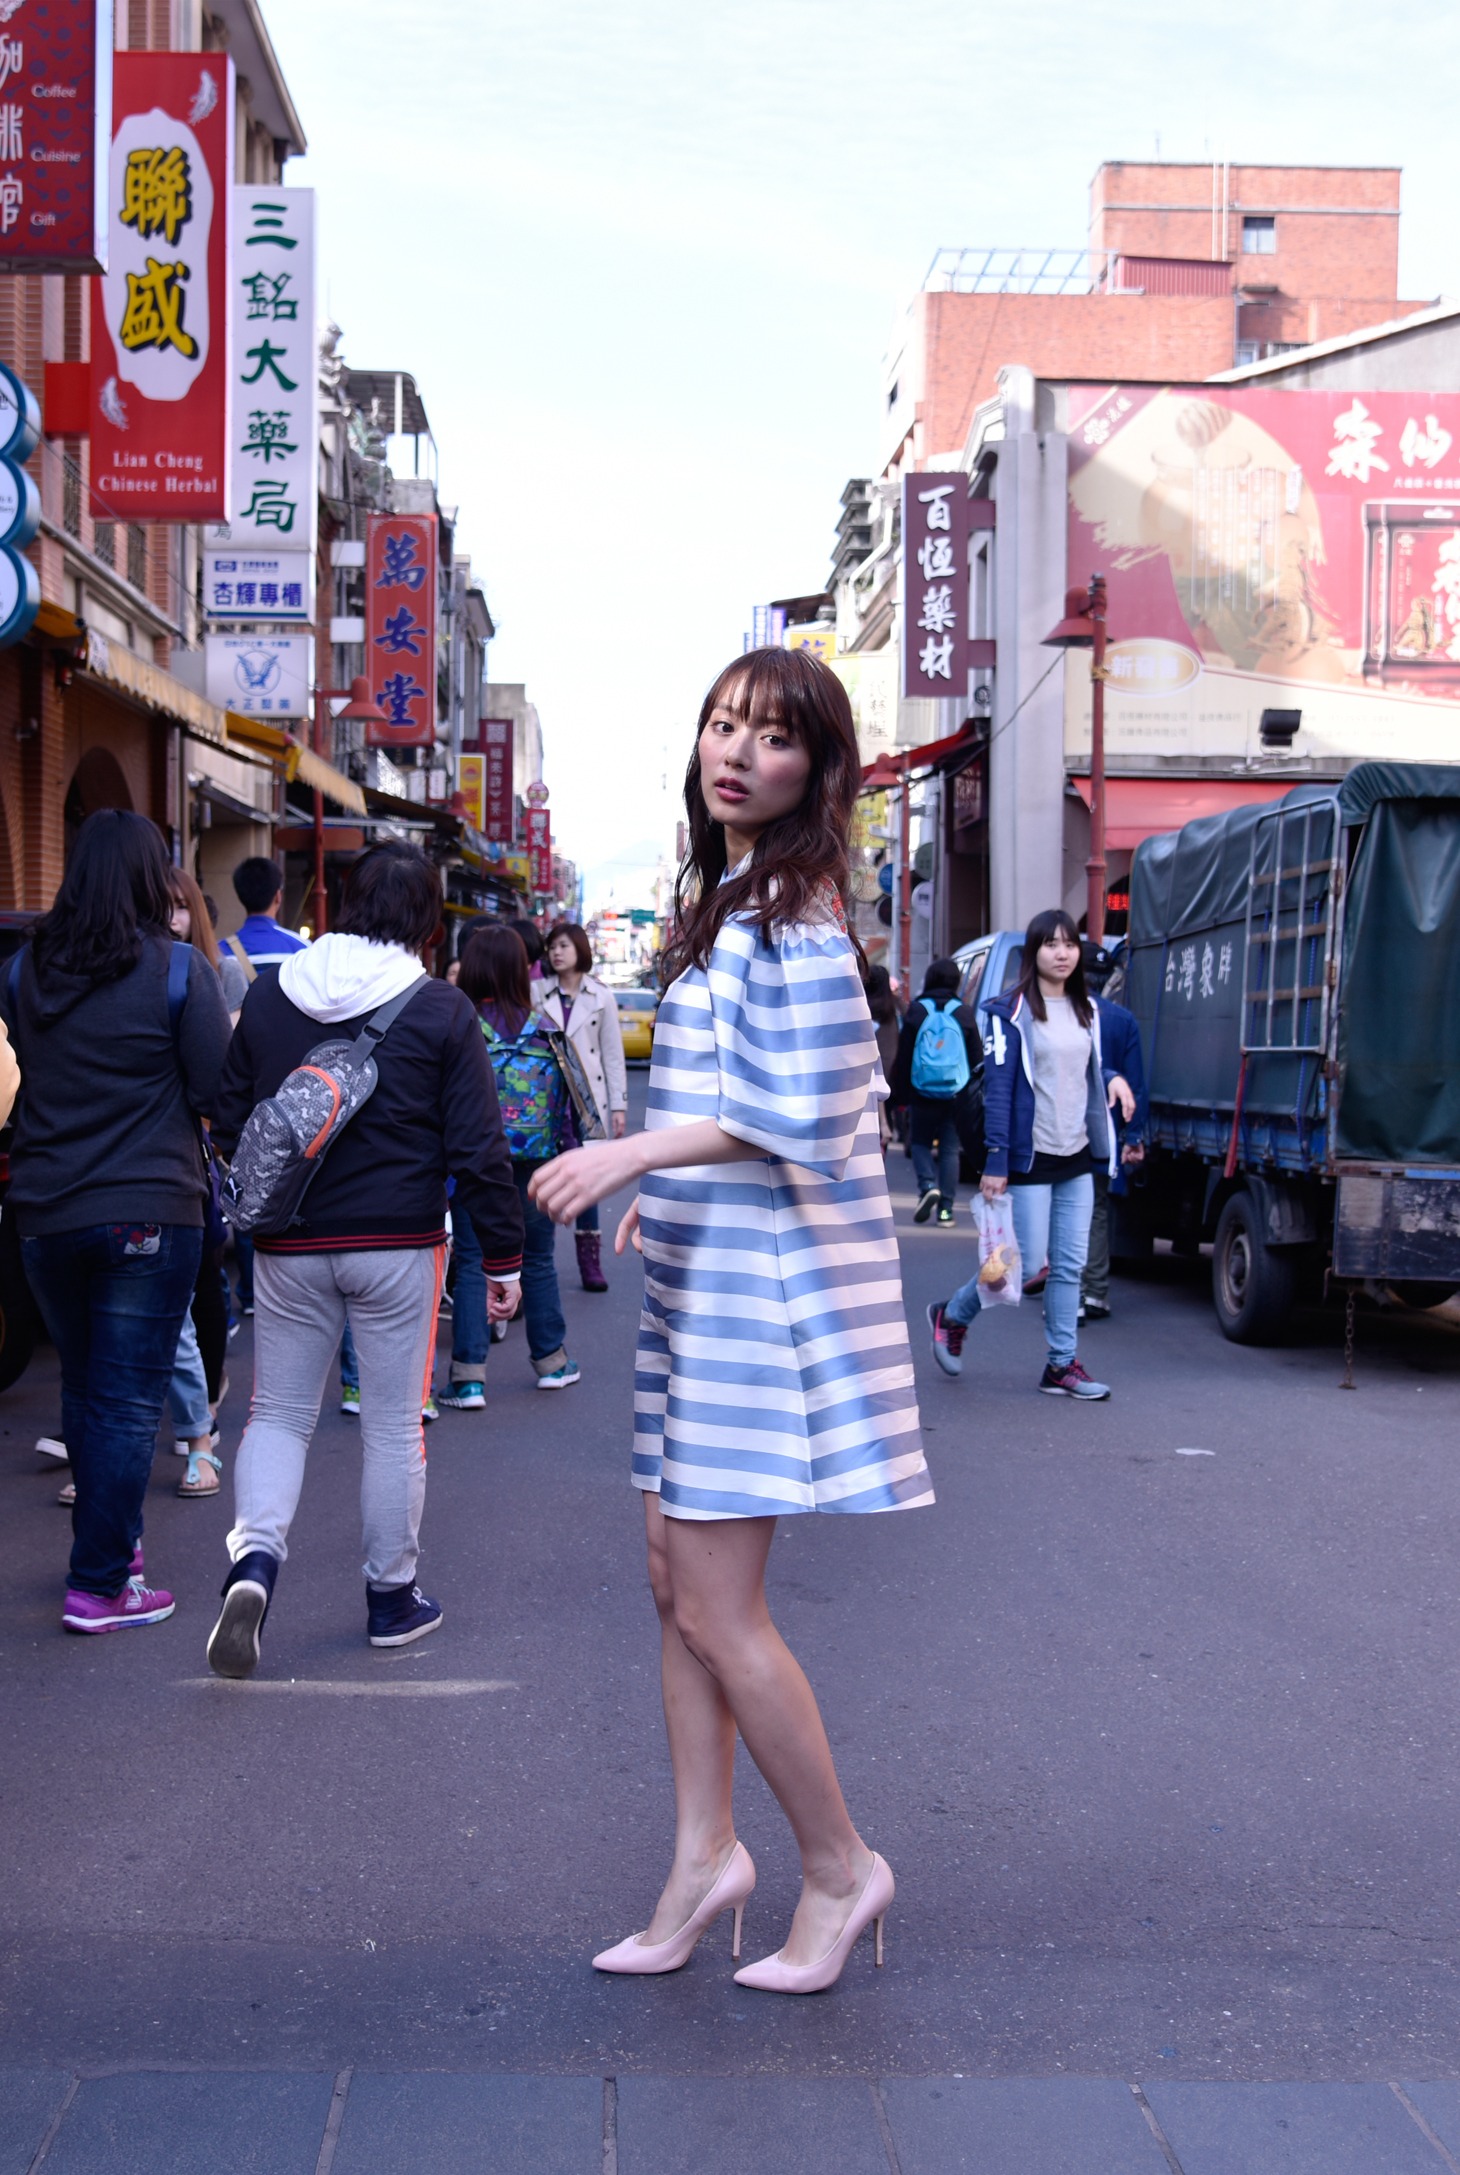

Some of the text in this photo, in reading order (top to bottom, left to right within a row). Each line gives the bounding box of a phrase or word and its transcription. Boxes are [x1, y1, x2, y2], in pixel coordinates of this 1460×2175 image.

[31, 84, 77, 98] Coffee
[31, 148, 81, 163] Cuisine
[30, 212, 57, 226] Gift
[119, 146, 198, 359] 聯盛
[240, 203, 299, 534] 三銘大藥局
[112, 450, 204, 472] Lian Cheng
[98, 474, 218, 493] Chinese Herbal
[917, 485, 957, 680] 百恆藥材
[374, 533, 428, 727] 萬安堂
